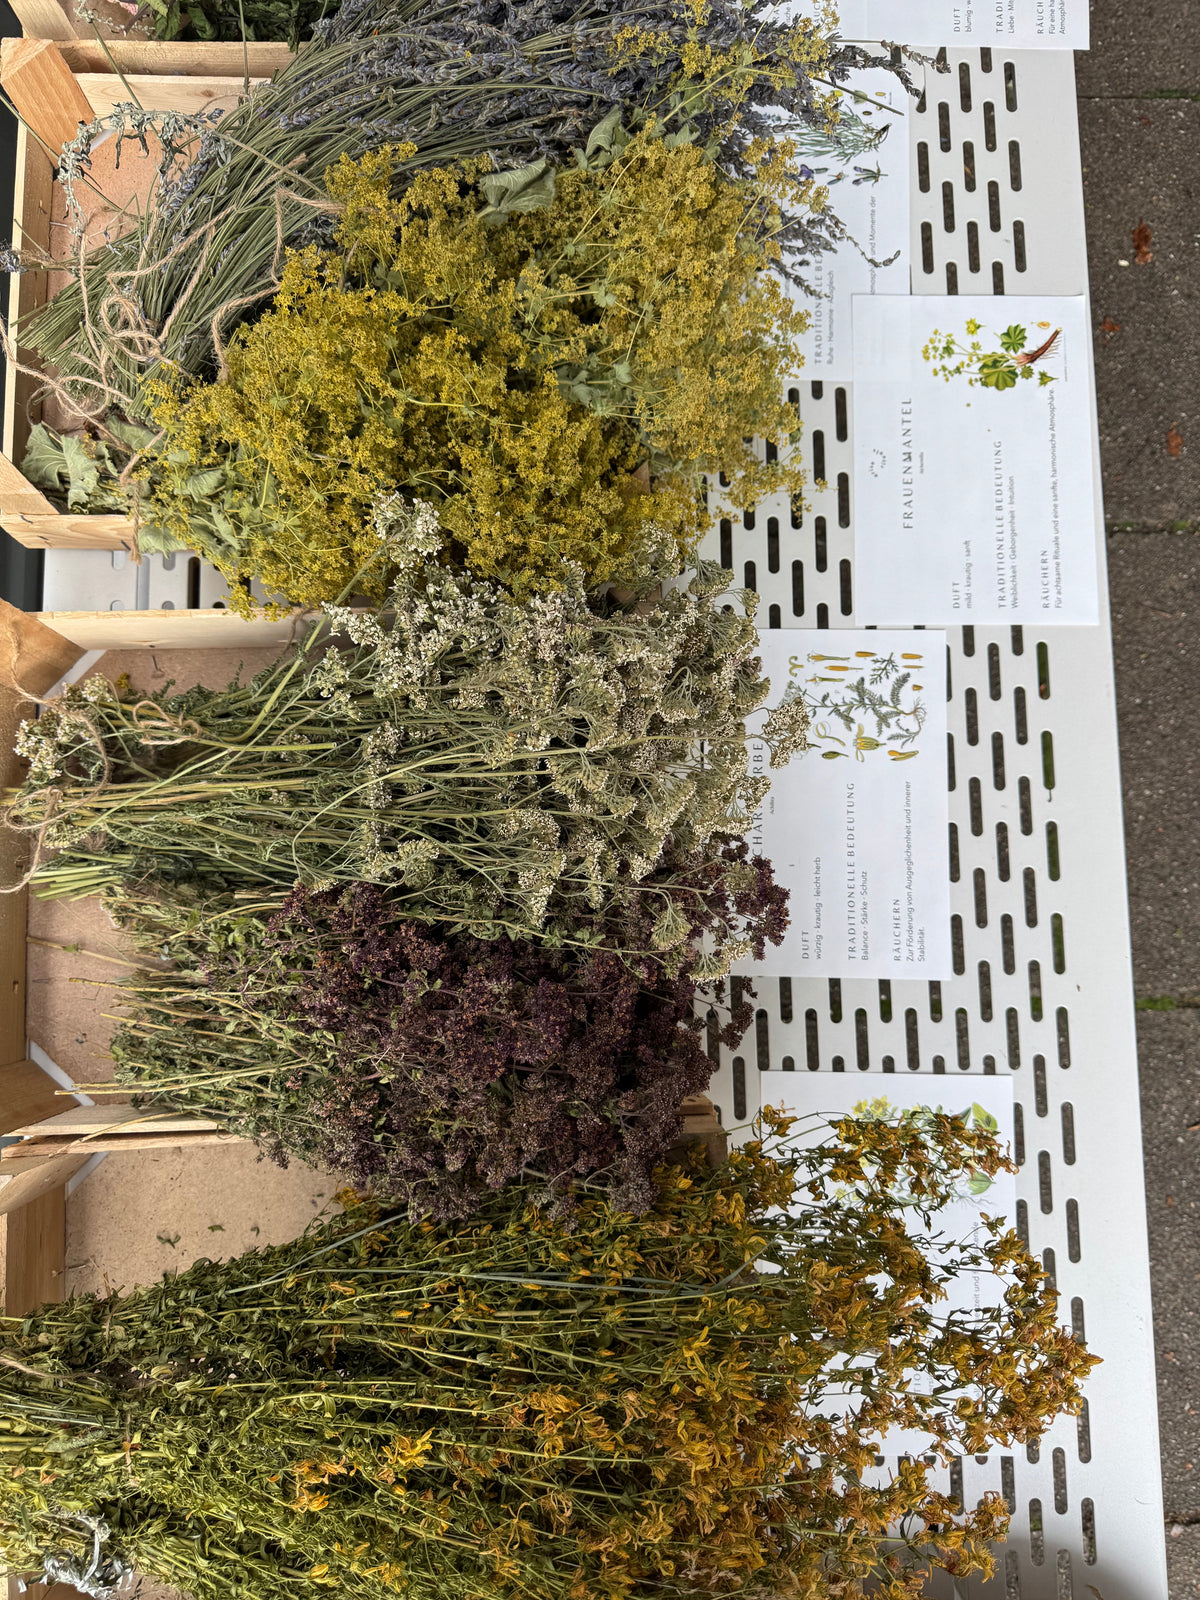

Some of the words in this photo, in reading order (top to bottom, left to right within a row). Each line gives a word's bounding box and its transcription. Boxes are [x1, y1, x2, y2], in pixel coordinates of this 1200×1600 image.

[965, 10, 973, 32] blumig
[1048, 388, 1056, 431] Atmosphäre.
[1049, 433, 1057, 478] harmonische
[993, 441, 1003, 511] BEDEUTUNG
[1007, 476, 1015, 505] Intuition
[1050, 479, 1058, 502] sanfte,
[1008, 510, 1018, 560] Geborgenheit
[1051, 520, 1060, 534] und
[963, 540, 971, 557] sanft
[995, 516, 1007, 608] TRADITIONELLE
[1052, 536, 1060, 560] Rituale
[963, 563, 973, 587] krautig
[1010, 565, 1019, 609] Weiblichkeit
[1040, 550, 1050, 608] RÄUCHERN
[1054, 561, 1062, 595] achtsame
[952, 582, 960, 608] DUFT
[964, 593, 972, 609] mild
[847, 784, 855, 856] BEDEUTUNG
[813, 857, 821, 874] herb
[904, 825, 914, 890] Ausgeglichenheit
[813, 876, 821, 897] leicht
[860, 871, 868, 896] Schutz
[814, 903, 823, 928] krautig
[847, 862, 856, 960] TRADITIONELLE
[860, 901, 868, 924] Stärke
[893, 899, 901, 961] RÄUCHERN
[906, 907, 915, 947] Förderung
[801, 930, 809, 959] DUFT
[814, 935, 823, 959] würzig
[861, 931, 869, 960] Balance
[906, 948, 914, 962] Zur
[917, 927, 926, 962] Stabilität.
